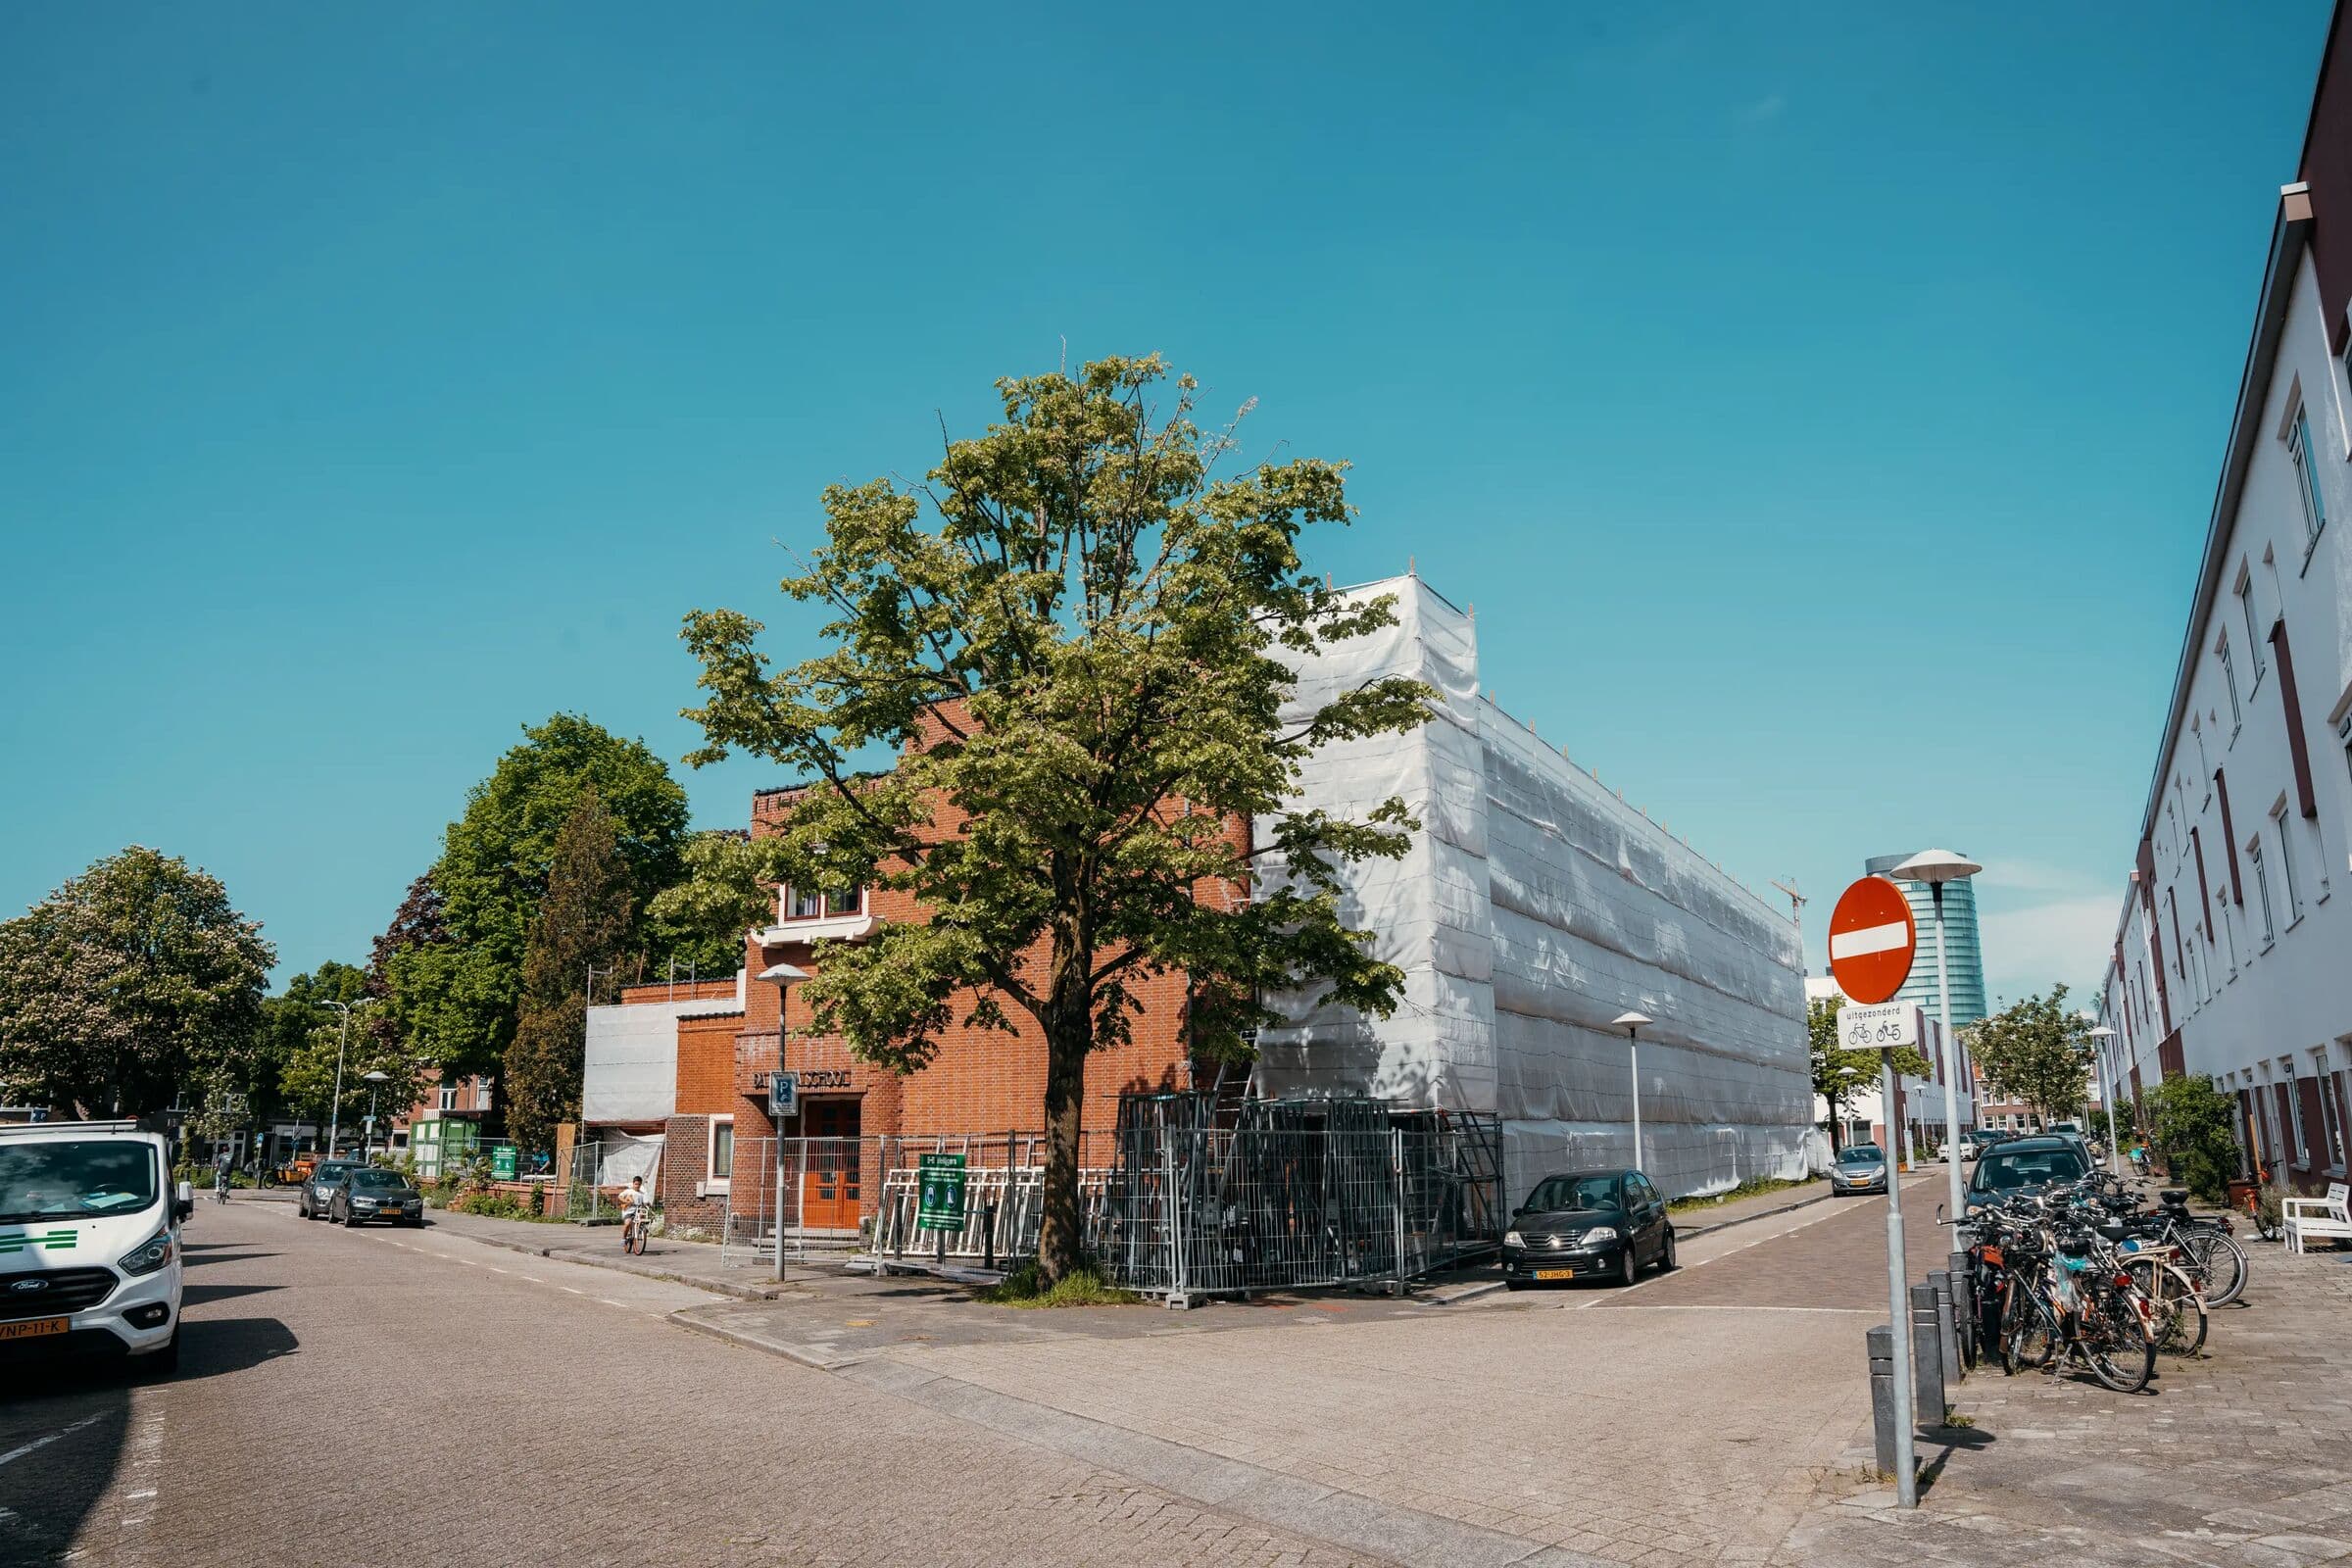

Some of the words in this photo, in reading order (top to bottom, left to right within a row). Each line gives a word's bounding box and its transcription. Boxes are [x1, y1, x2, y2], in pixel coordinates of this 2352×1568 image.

[1846, 1005, 1900, 1020] uitgezonderd
[804, 1070, 851, 1086] SCHOOL
[780, 1081, 789, 1094] P
